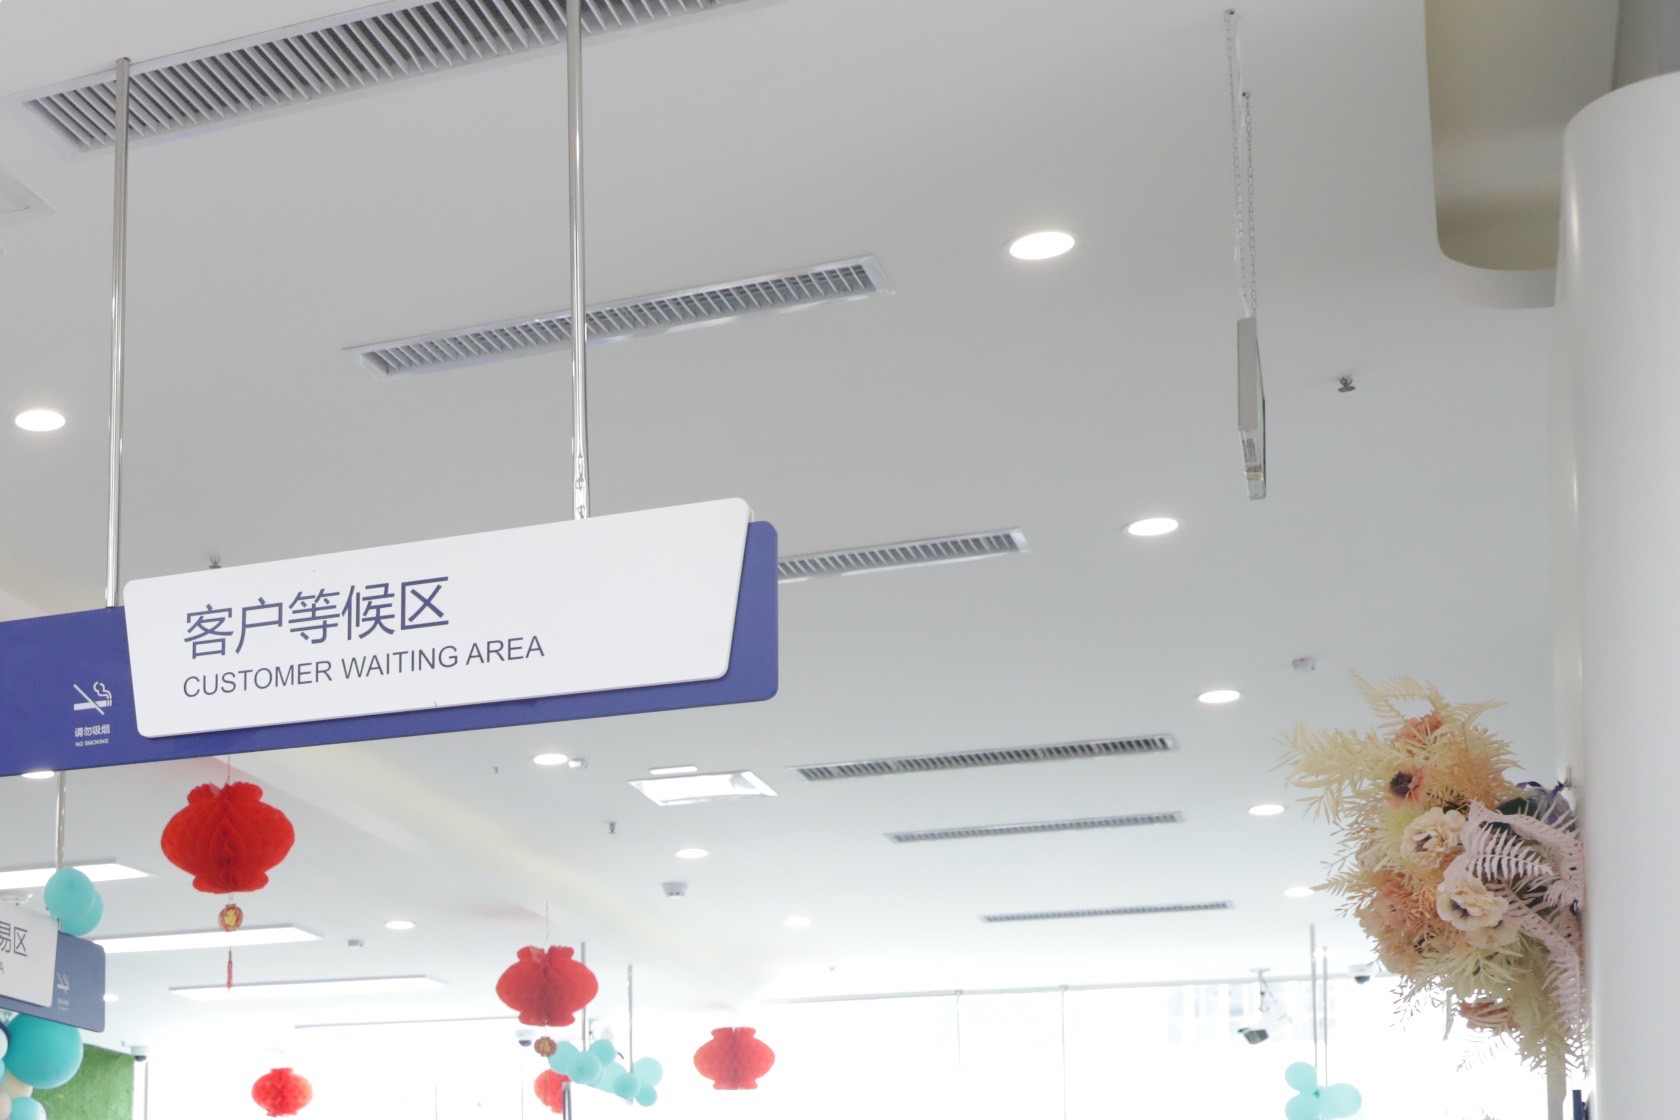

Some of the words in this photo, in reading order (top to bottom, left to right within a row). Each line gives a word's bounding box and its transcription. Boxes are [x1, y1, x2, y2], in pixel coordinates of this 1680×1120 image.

[183, 576, 449, 659] 客户等候区
[183, 660, 333, 698] CUSTOMER
[341, 645, 459, 680] WAITING
[465, 635, 545, 666] AREA
[74, 724, 110, 737] 请勿吸烟
